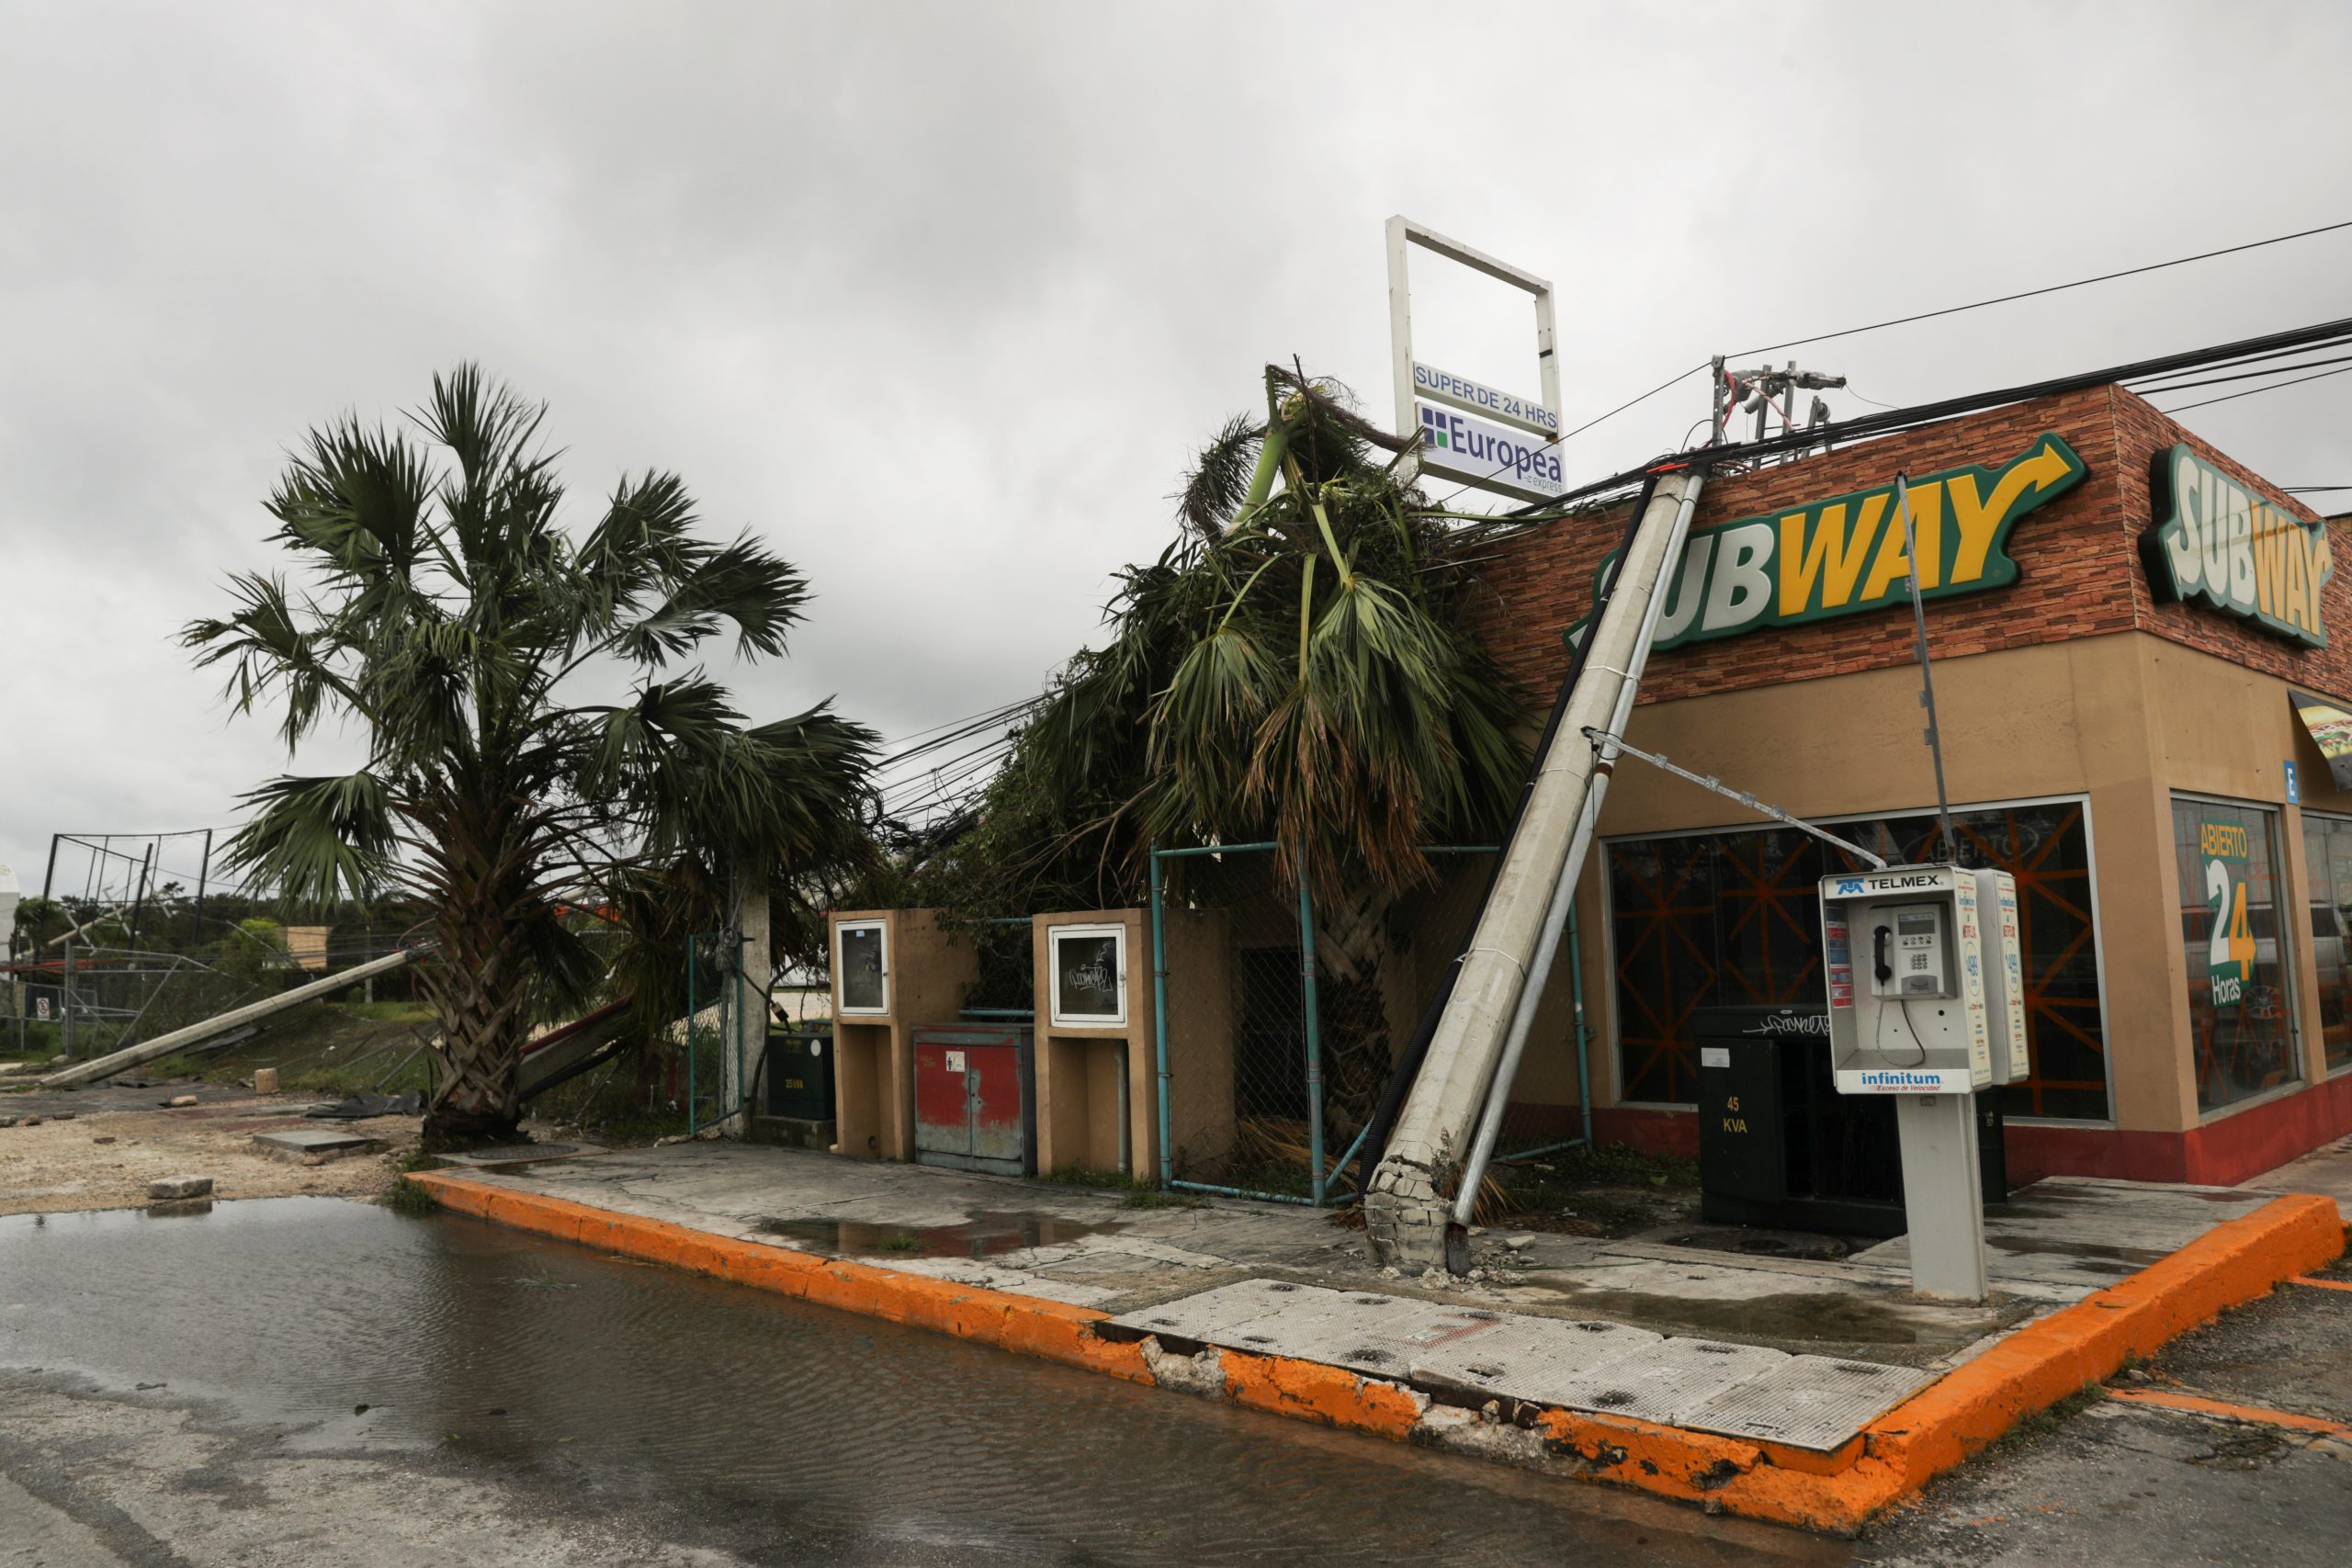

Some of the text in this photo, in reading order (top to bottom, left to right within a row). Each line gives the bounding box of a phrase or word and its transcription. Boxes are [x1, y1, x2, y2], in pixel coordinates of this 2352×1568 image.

[1416, 366, 1557, 429] SUPER DE 24 HRS
[1450, 416, 1562, 483] Europea
[1532, 476, 1562, 493] express
[1569, 443, 2071, 649] UBWAY
[2166, 456, 2334, 637] SUBWAY
[2200, 822, 2248, 858] ABIERTO
[1868, 874, 1939, 890] TELMEX
[2205, 859, 2257, 982] 24
[2211, 975, 2242, 1006] Horas
[1861, 1072, 1941, 1085] infinitum
[1726, 1096, 1739, 1112] 45
[1723, 1118, 1747, 1133] KVA
